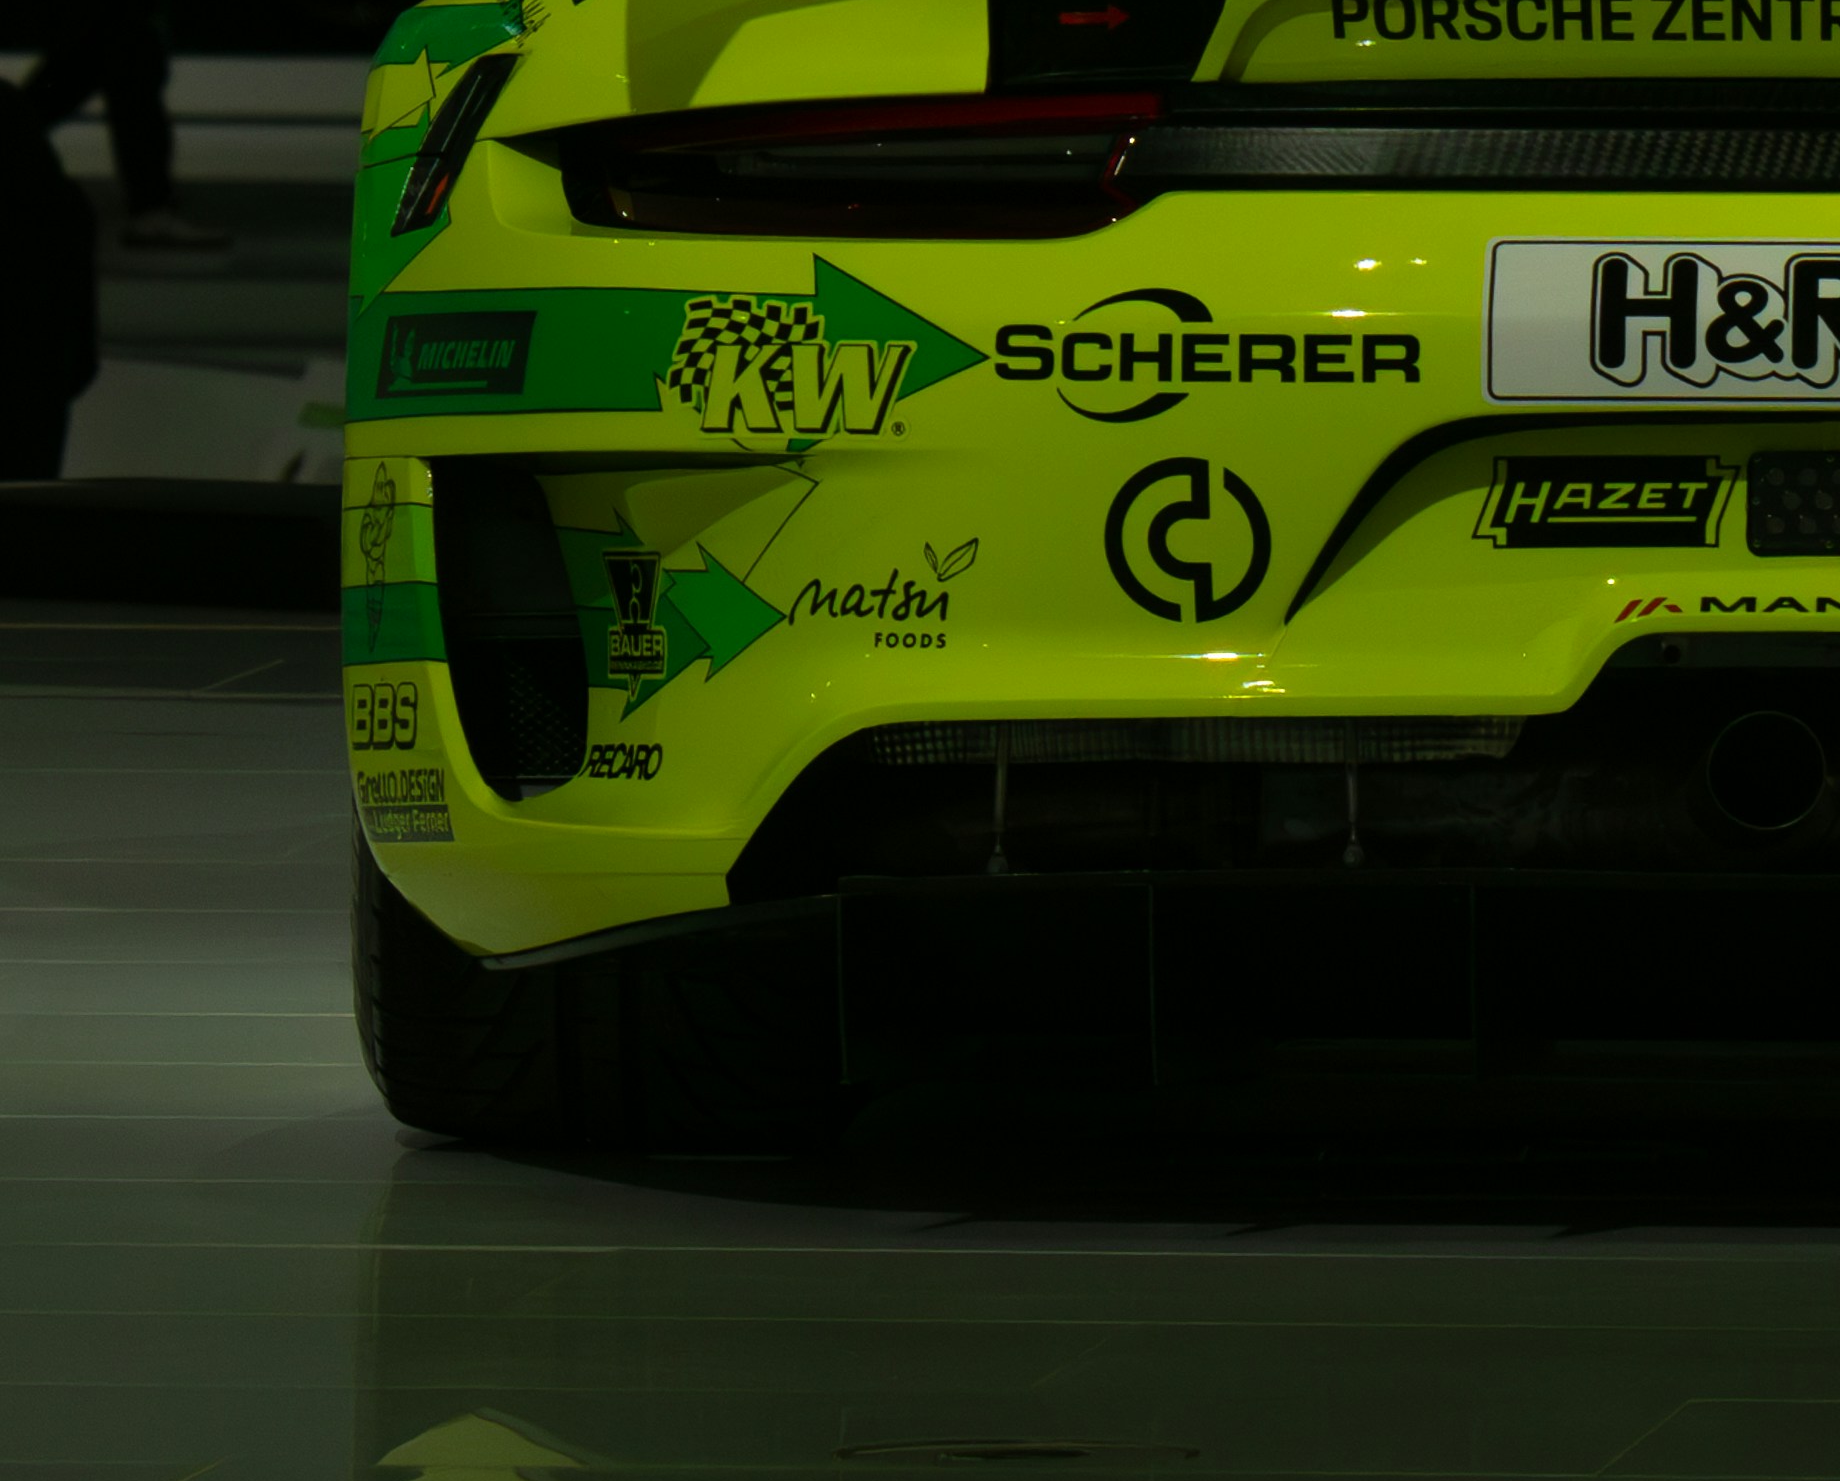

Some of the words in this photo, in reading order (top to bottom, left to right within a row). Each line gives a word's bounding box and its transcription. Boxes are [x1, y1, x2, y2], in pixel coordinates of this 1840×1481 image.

[417, 338, 515, 372] MICHELIN
[994, 324, 1421, 383] SCHERER
[1505, 479, 1709, 524] HAZET
[610, 633, 664, 658] BAUER
[875, 632, 947, 649] FOODS
[352, 681, 418, 750] BBS
[585, 743, 663, 780] RECARO
